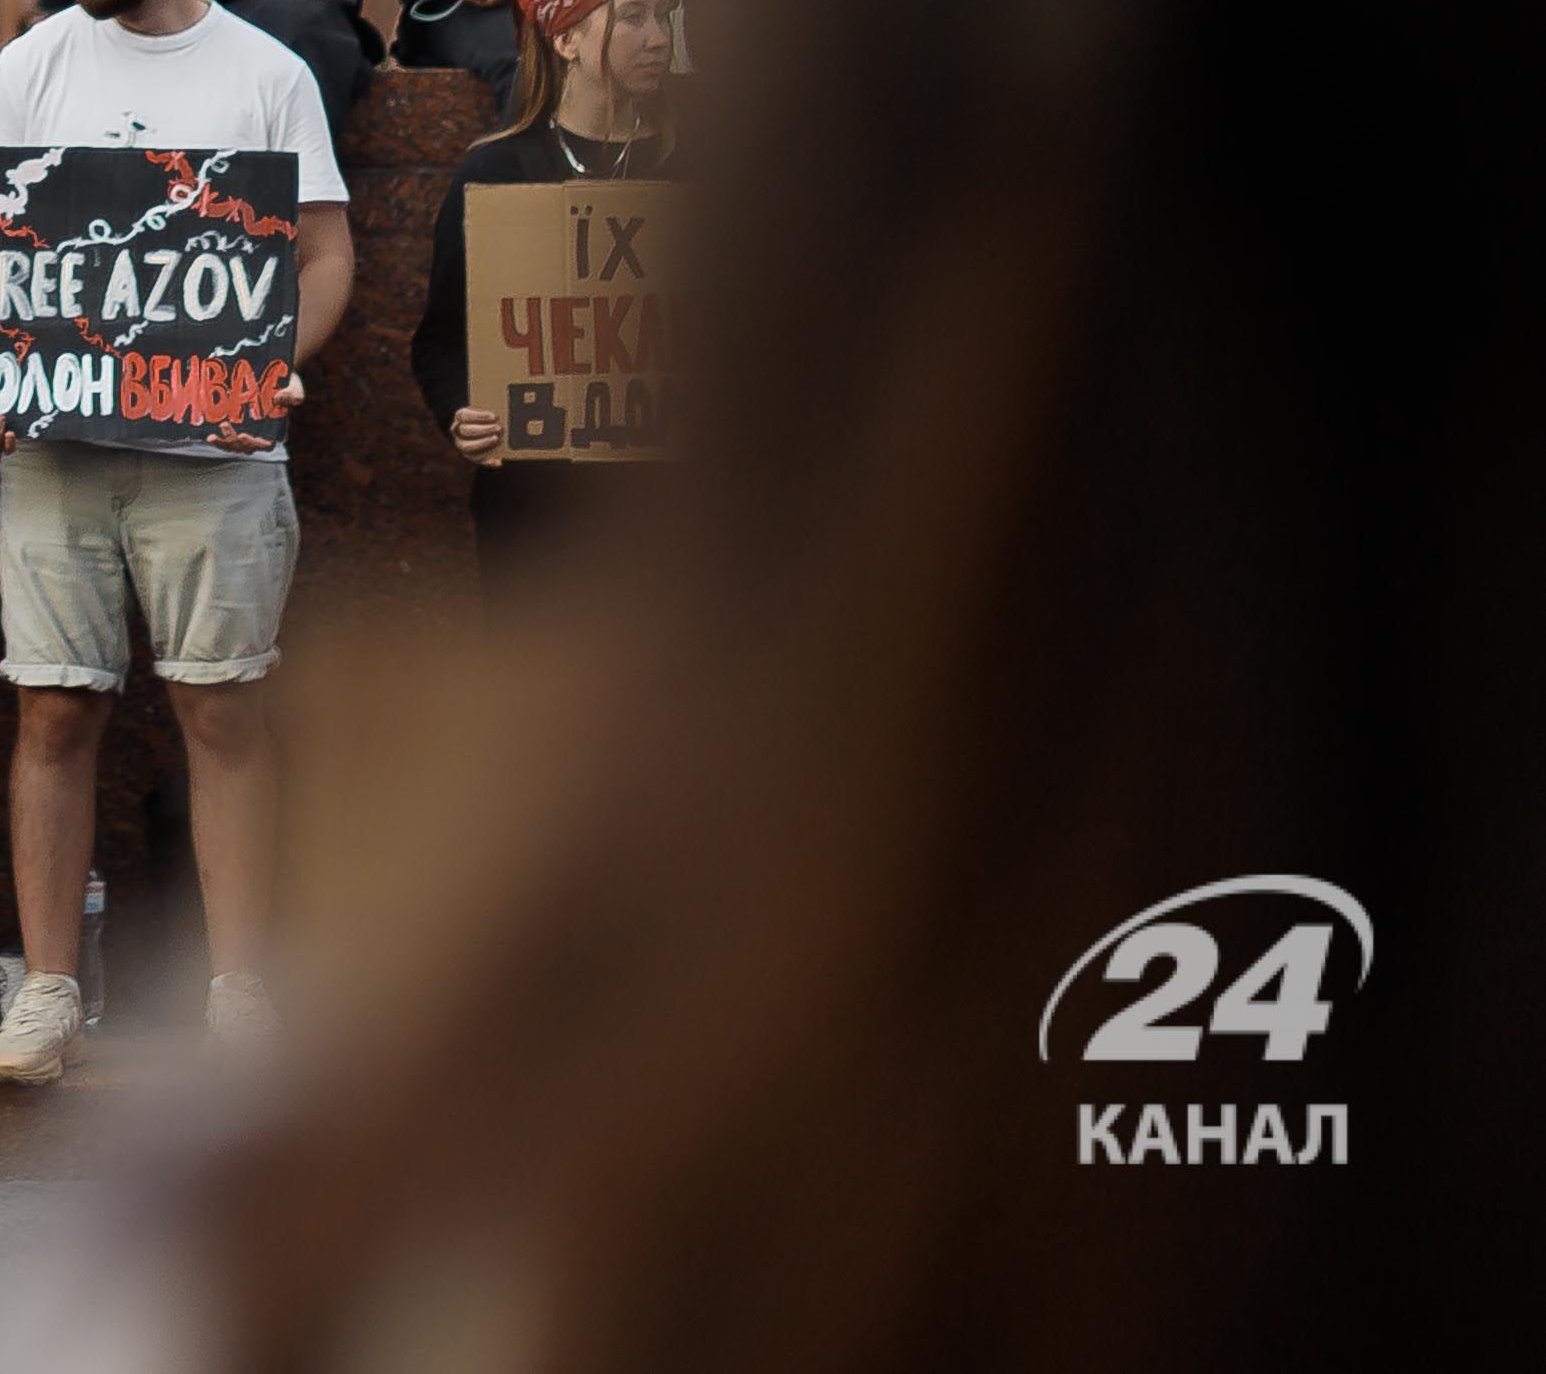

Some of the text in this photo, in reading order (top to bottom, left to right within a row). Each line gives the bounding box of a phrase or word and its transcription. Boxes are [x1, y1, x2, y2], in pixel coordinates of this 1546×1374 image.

[569, 205, 647, 282] ЇХ
[101, 249, 278, 322] AZOV
[120, 354, 289, 426] ВБИВАЄ
